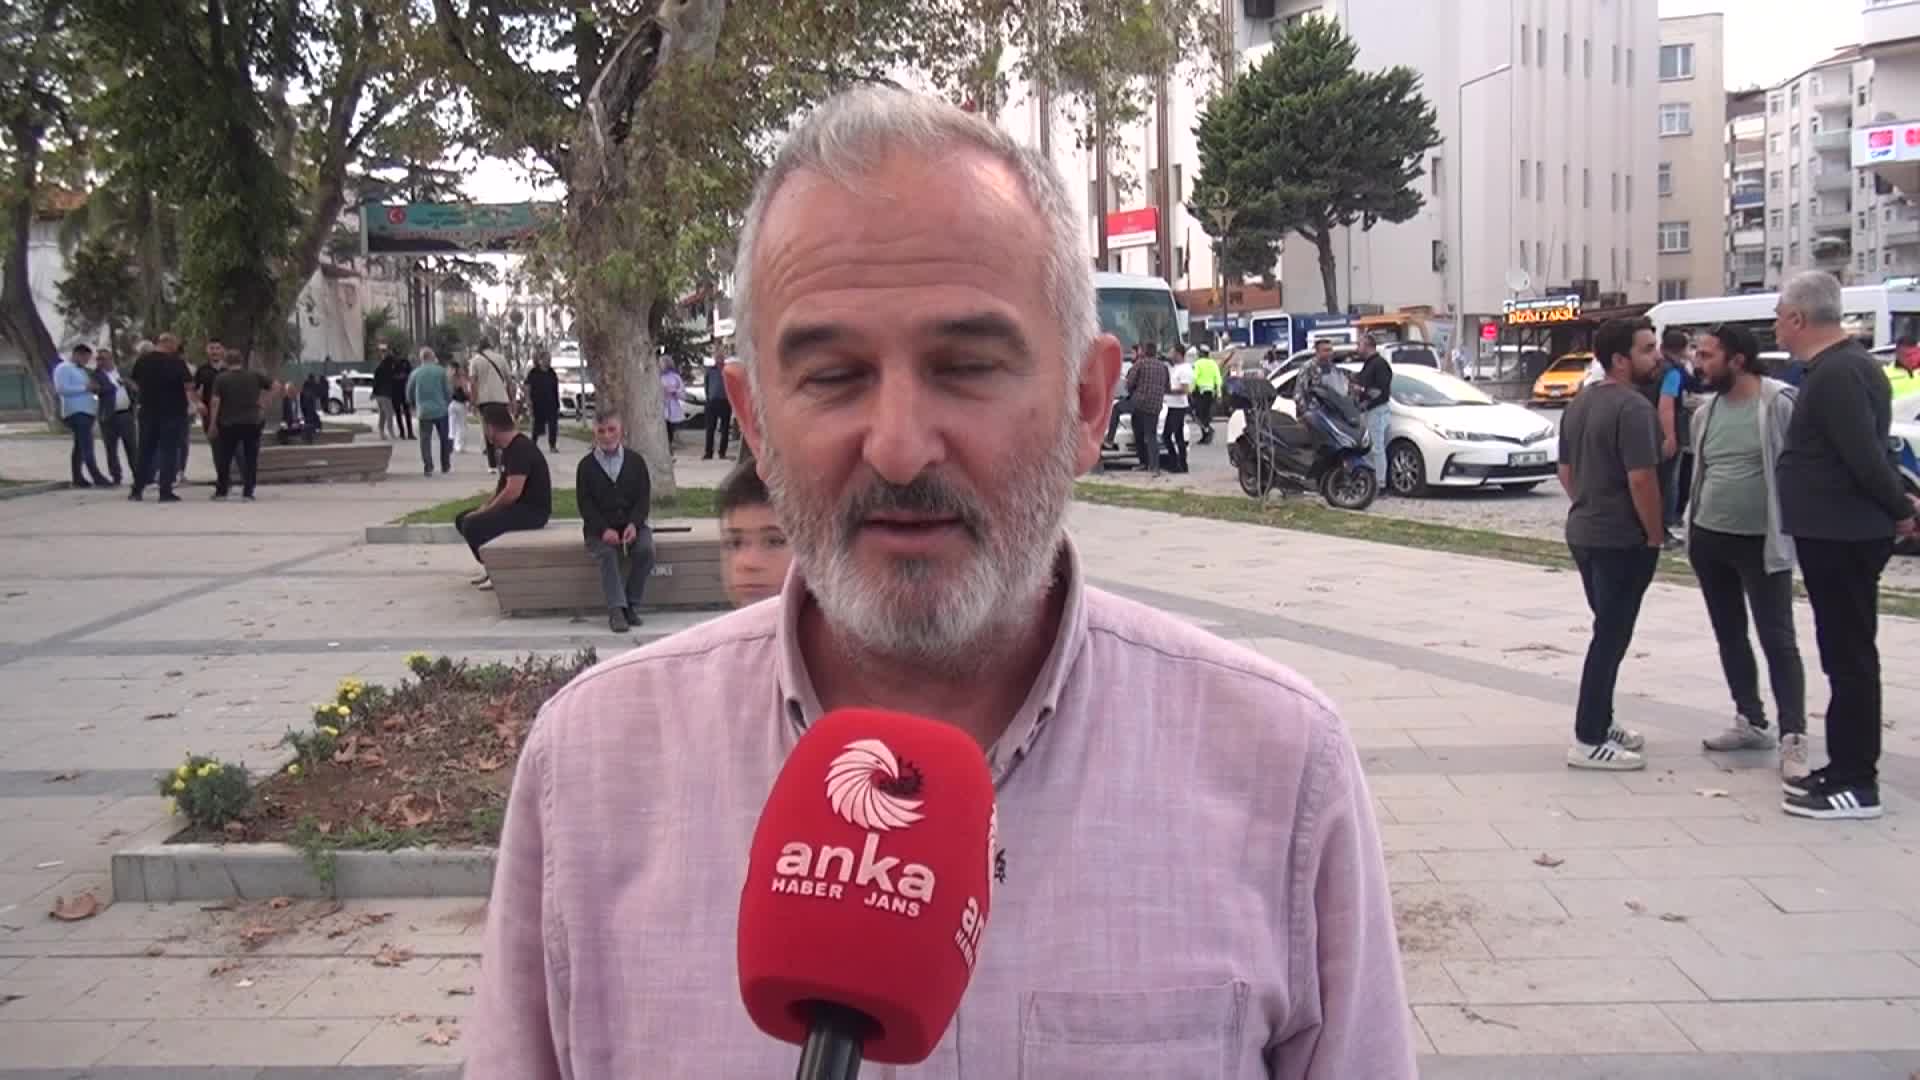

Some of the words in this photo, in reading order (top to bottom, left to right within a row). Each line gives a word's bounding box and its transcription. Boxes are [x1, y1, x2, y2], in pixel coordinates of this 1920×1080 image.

[775, 832, 936, 904] anka
[771, 878, 844, 900] HABER
[863, 891, 921, 918] JANS
